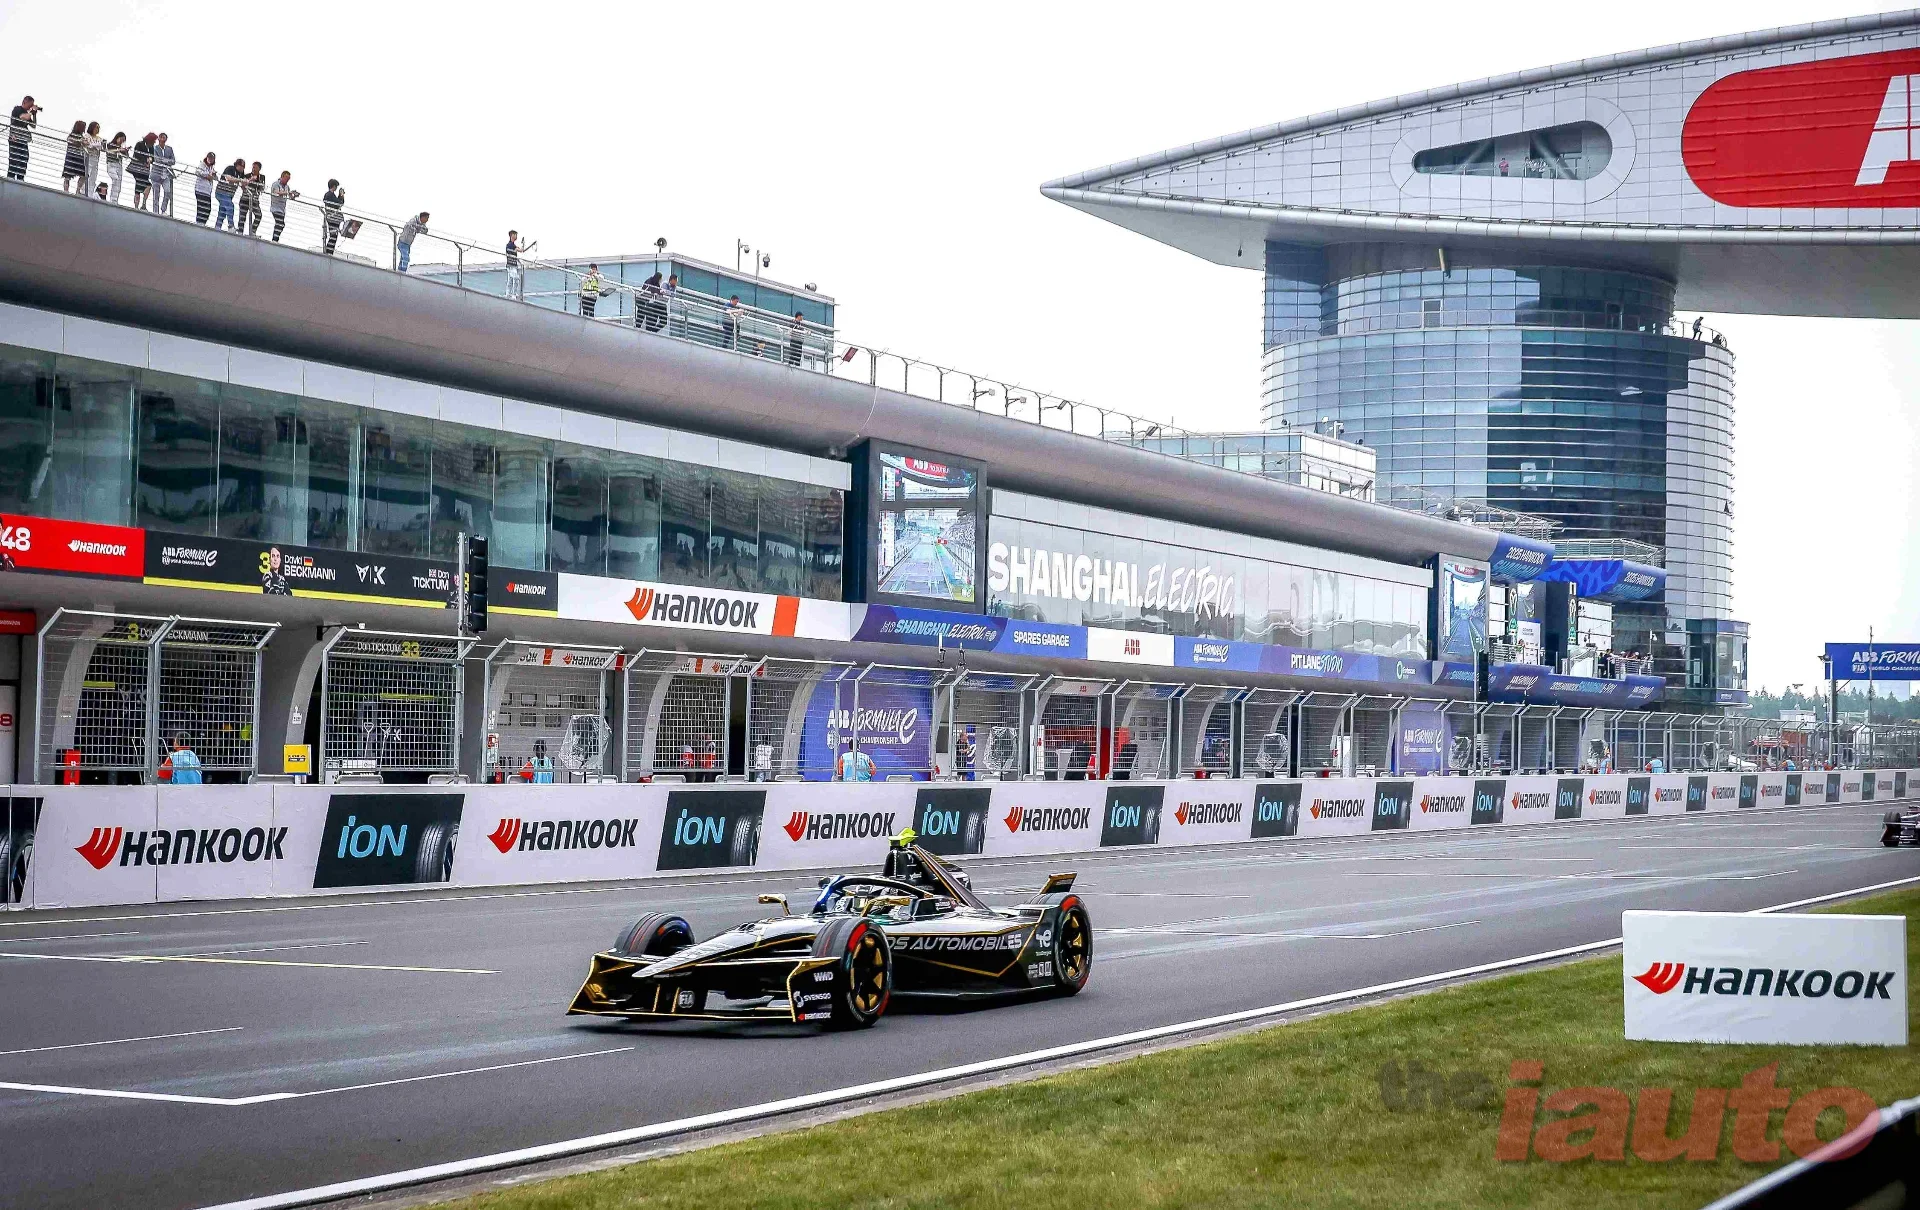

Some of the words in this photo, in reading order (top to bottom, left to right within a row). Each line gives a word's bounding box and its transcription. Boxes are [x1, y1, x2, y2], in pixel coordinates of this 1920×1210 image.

[1, 526, 31, 551] 48
[284, 564, 336, 580] BECKMANN
[412, 576, 449, 591] TICKTUM
[1013, 630, 1042, 645] SPARES
[1041, 632, 1070, 647] GARAGE
[1124, 638, 1141, 656] ABB
[1290, 653, 1303, 669] PIT
[1302, 655, 1321, 670] LANE
[921, 803, 960, 836] iON
[1110, 800, 1141, 828] iON
[673, 808, 726, 846] iON
[337, 815, 408, 859] iON
[909, 933, 1022, 951] AUTOMOBILES
